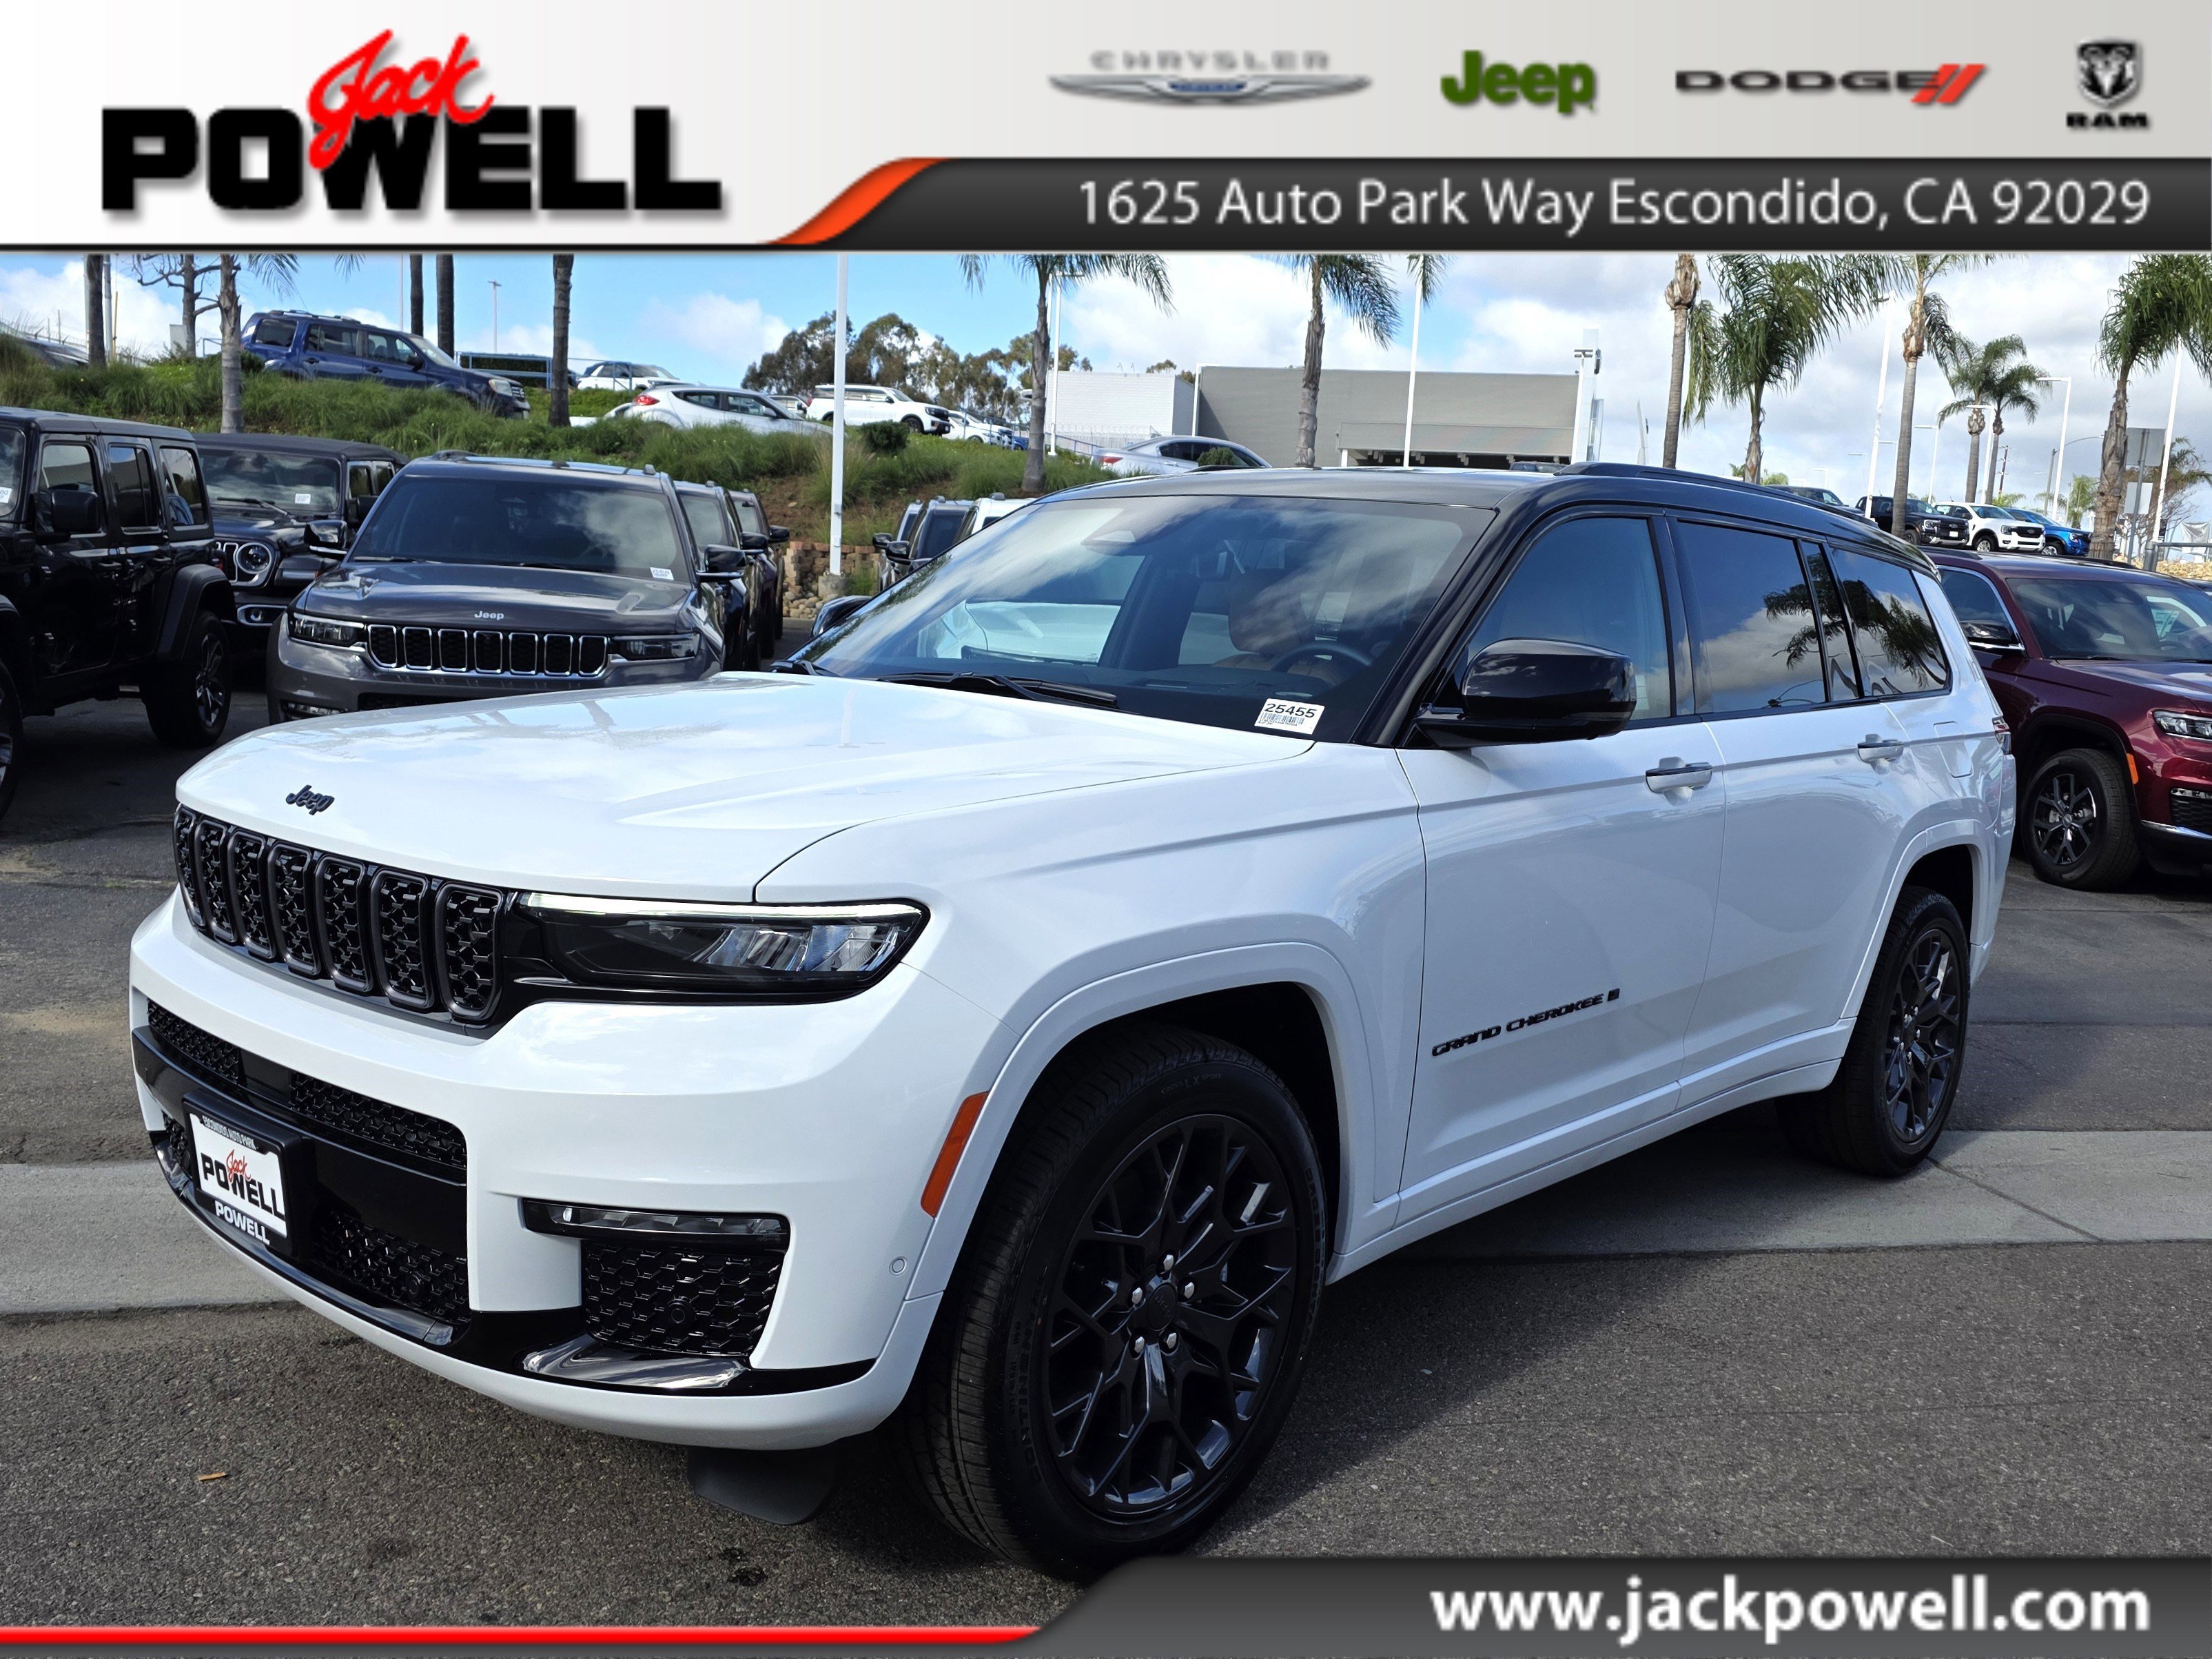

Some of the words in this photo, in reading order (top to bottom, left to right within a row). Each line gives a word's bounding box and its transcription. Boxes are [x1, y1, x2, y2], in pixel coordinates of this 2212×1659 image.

[473, 610, 504, 621] Jeep
[1264, 703, 1318, 718] 25455
[285, 784, 335, 816] Jeep
[1431, 1024, 1502, 1057] GRAND
[1506, 993, 1604, 1032] CHEROKEE
[226, 1149, 252, 1182] Jack
[201, 1152, 285, 1221] POWELL
[214, 1200, 270, 1245] POWELL
